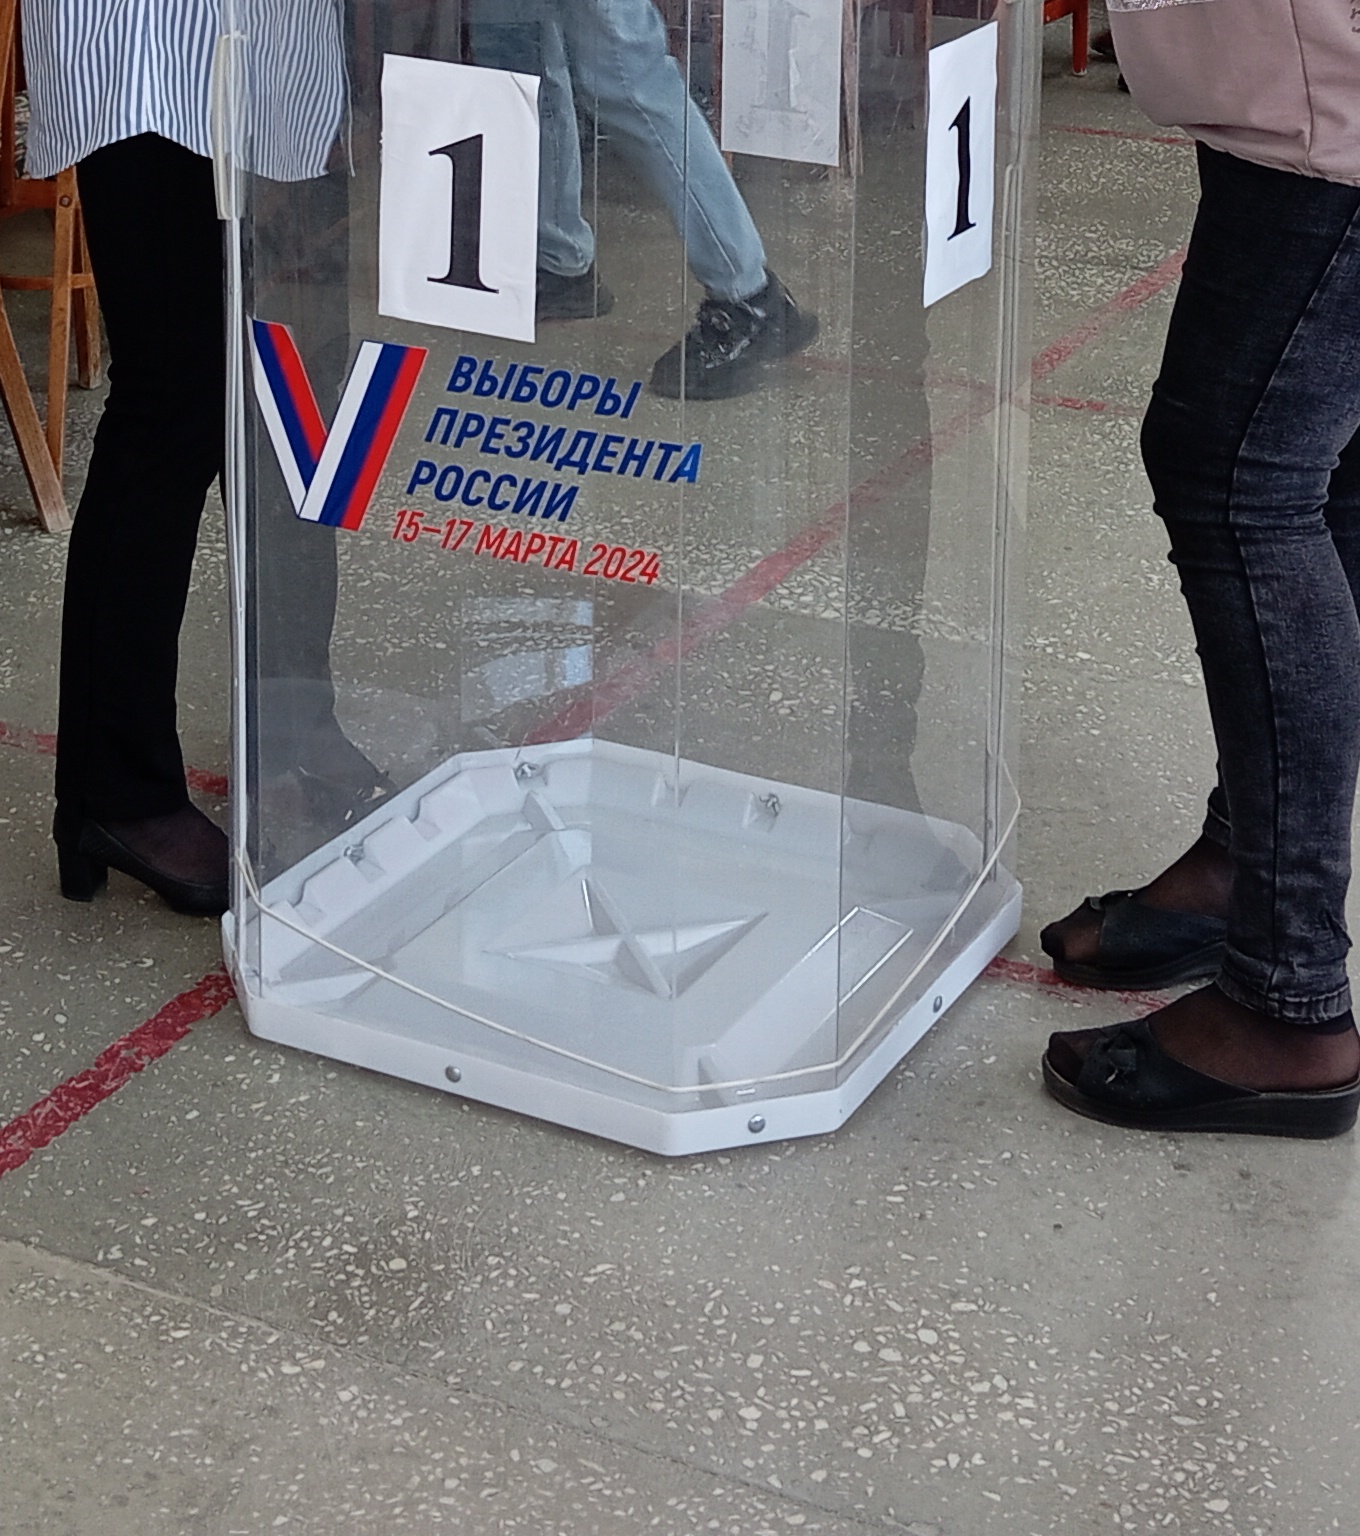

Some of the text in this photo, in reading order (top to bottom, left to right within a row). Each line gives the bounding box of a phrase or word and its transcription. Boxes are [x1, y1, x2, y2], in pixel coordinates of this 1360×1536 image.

[946, 95, 977, 244] 1
[424, 133, 501, 296] 1
[446, 354, 644, 420] ВЫБОРЫ
[423, 406, 705, 484] ПРЕЗИДЕНТА
[406, 459, 580, 524] РОССИИ
[474, 524, 580, 573] МАРТА
[583, 543, 662, 586] 2024
